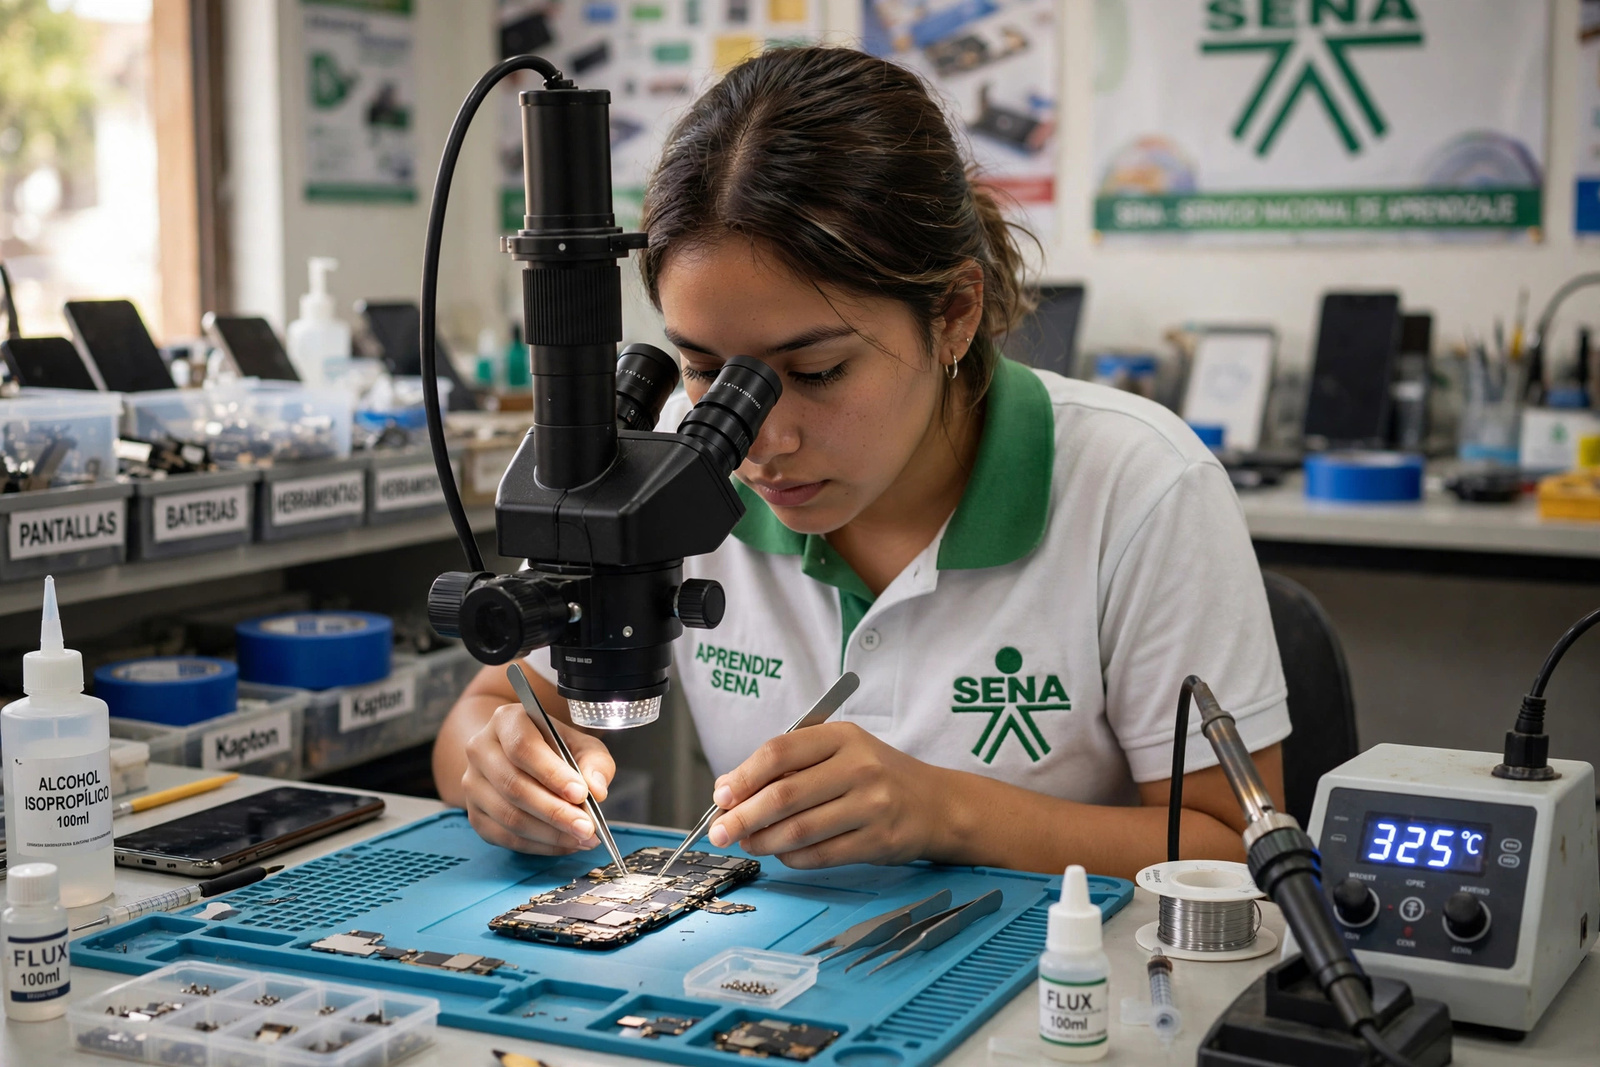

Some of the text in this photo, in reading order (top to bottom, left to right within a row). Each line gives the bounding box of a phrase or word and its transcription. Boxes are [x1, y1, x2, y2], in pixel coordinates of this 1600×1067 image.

[1206, 0, 1418, 31] SENA
[166, 498, 238, 530] BATERIAS
[19, 511, 117, 547] PANTALLAS
[696, 642, 783, 679] APRENDIZ
[711, 669, 760, 699] SENA
[953, 675, 1070, 704] SENA
[351, 689, 405, 717] Kapton
[215, 727, 279, 762] Kapton
[39, 770, 100, 791] ALCOHOL
[25, 786, 109, 811] ISOPROPÍLICO
[57, 811, 89, 828] 100ml
[1368, 823, 1454, 867] 325
[14, 941, 67, 967] FLUX
[21, 967, 60, 986] 100ml
[1047, 989, 1092, 1011] FLUX
[1051, 1015, 1088, 1030] 100ml
